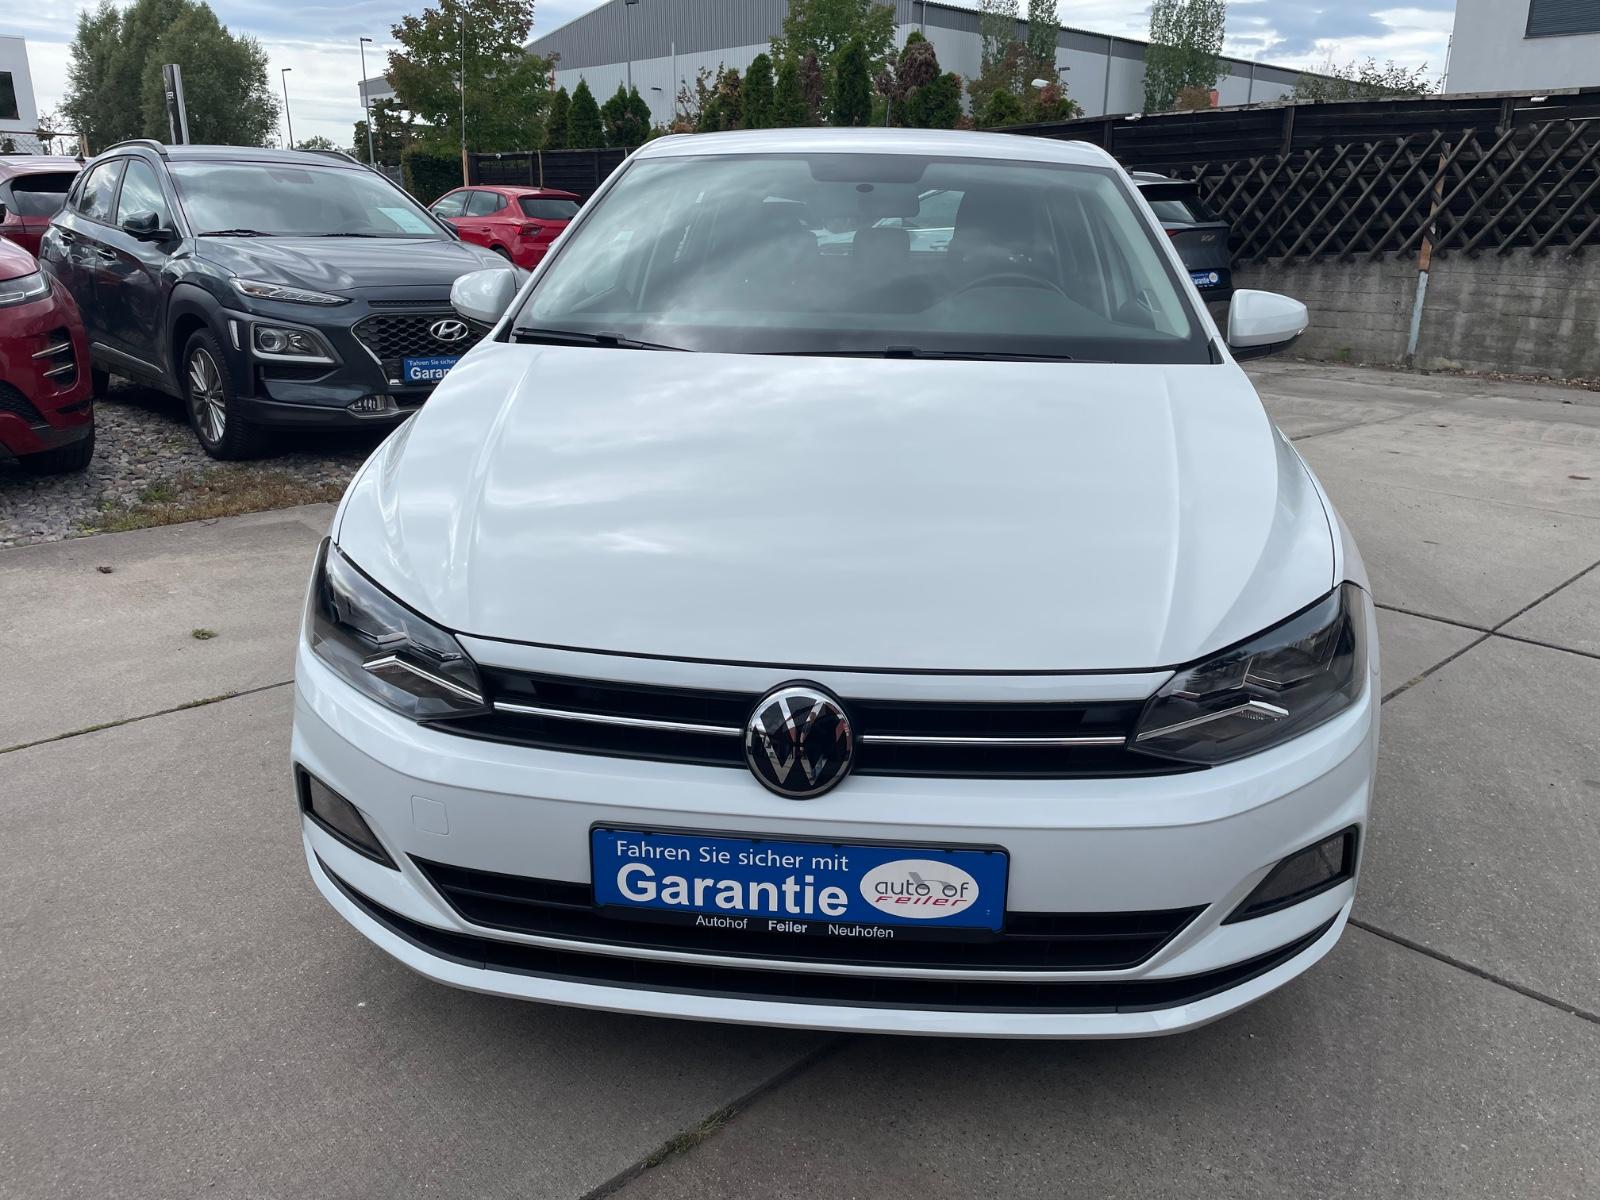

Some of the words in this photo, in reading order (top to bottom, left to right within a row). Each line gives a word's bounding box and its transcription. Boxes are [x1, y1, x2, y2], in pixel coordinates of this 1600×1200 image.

[616, 840, 691, 862] Fahren
[699, 846, 731, 865] Sie
[738, 849, 804, 869] sicher
[812, 853, 849, 872] mit
[616, 862, 849, 917] Garantie
[874, 895, 968, 906] Feiler
[695, 915, 748, 929] Autohof
[768, 920, 808, 934] Feiler
[828, 924, 895, 939] Neuhofen
